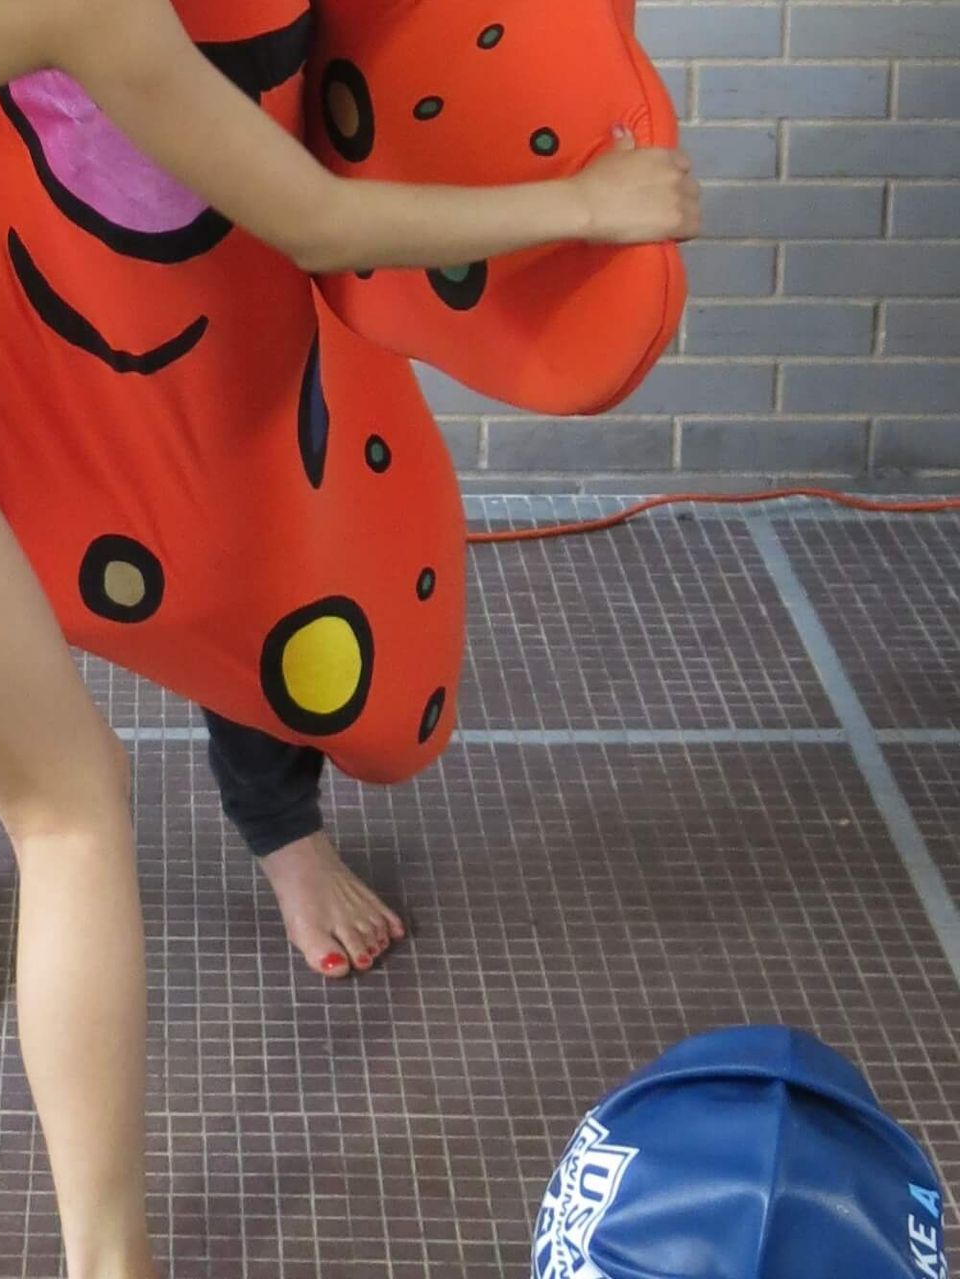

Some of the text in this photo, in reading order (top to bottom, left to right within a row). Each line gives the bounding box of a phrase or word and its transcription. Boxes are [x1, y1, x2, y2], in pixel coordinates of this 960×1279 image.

[564, 1164, 610, 1271] USA
[908, 1183, 940, 1279] KE A
